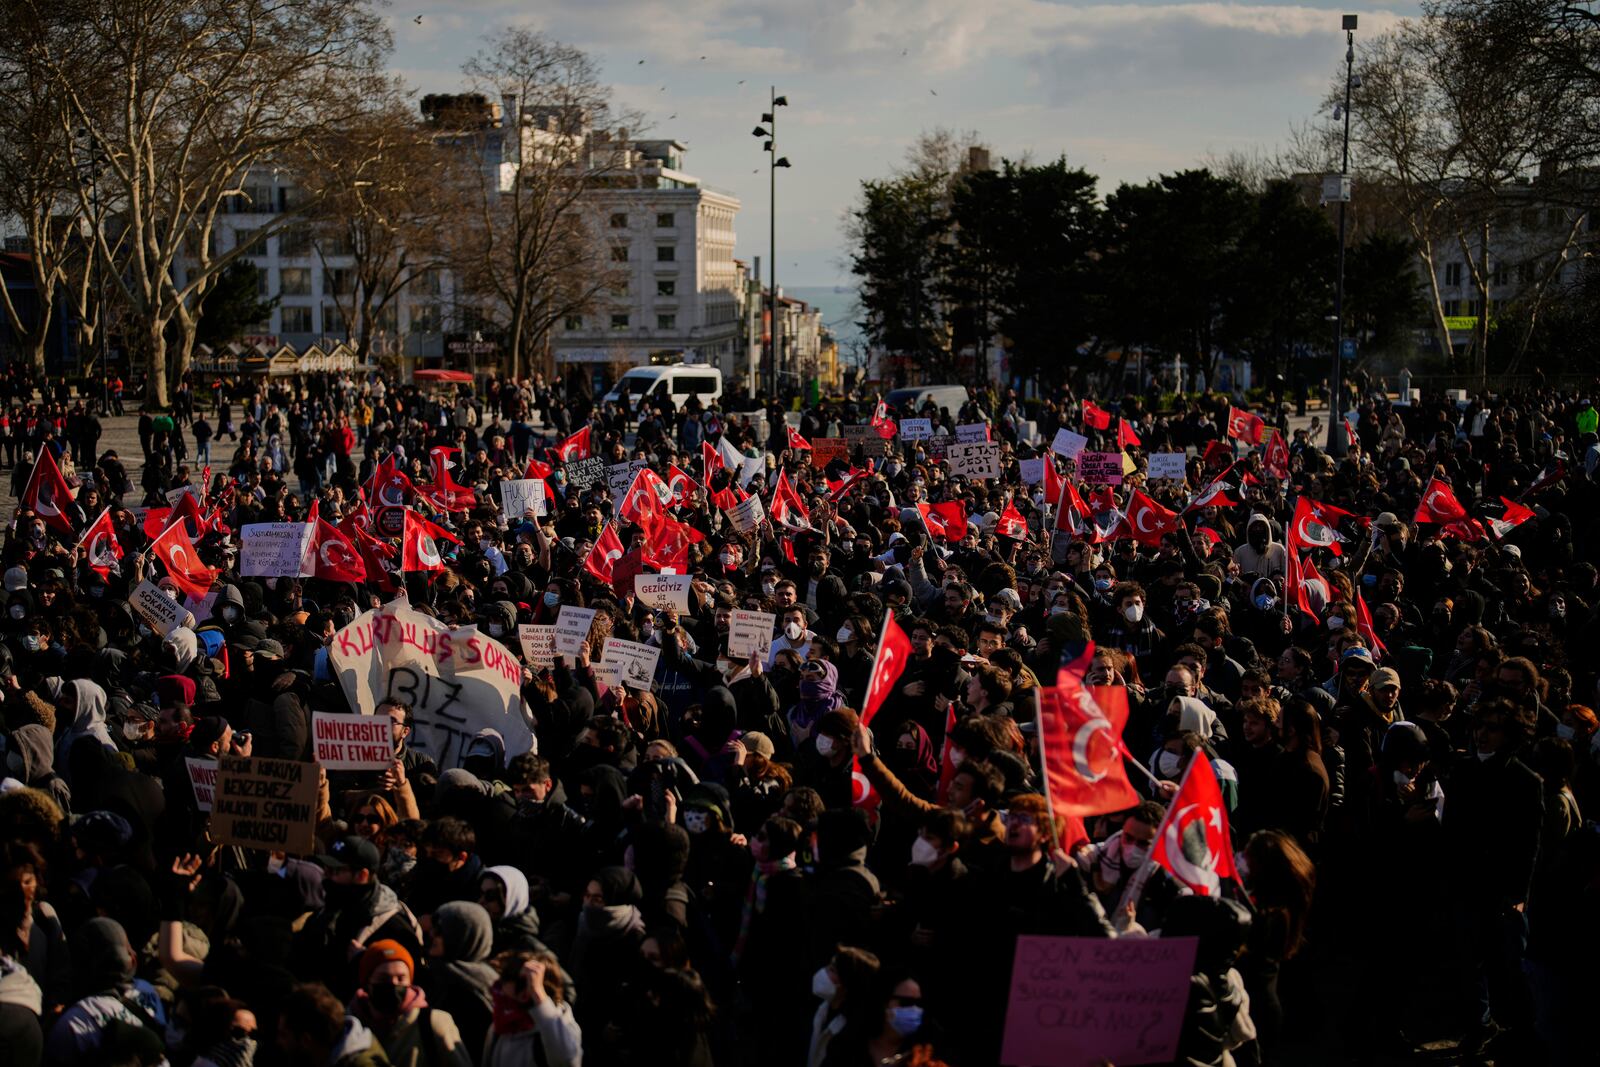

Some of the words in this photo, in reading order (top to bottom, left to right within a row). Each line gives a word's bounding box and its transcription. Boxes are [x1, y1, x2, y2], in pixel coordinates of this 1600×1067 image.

[966, 465, 992, 474] MOI
[641, 582, 682, 593] GEZİCİYİZ
[139, 591, 177, 623] SOKAKTA
[387, 665, 467, 724] BİZ
[316, 719, 388, 742] ÜNİVERSİTE
[319, 742, 344, 761] BİAT
[348, 744, 390, 762] ETMEZ!
[258, 760, 302, 783] KORKUYA
[224, 778, 295, 800] BENZEMEZ
[231, 820, 289, 844] KORKUSU
